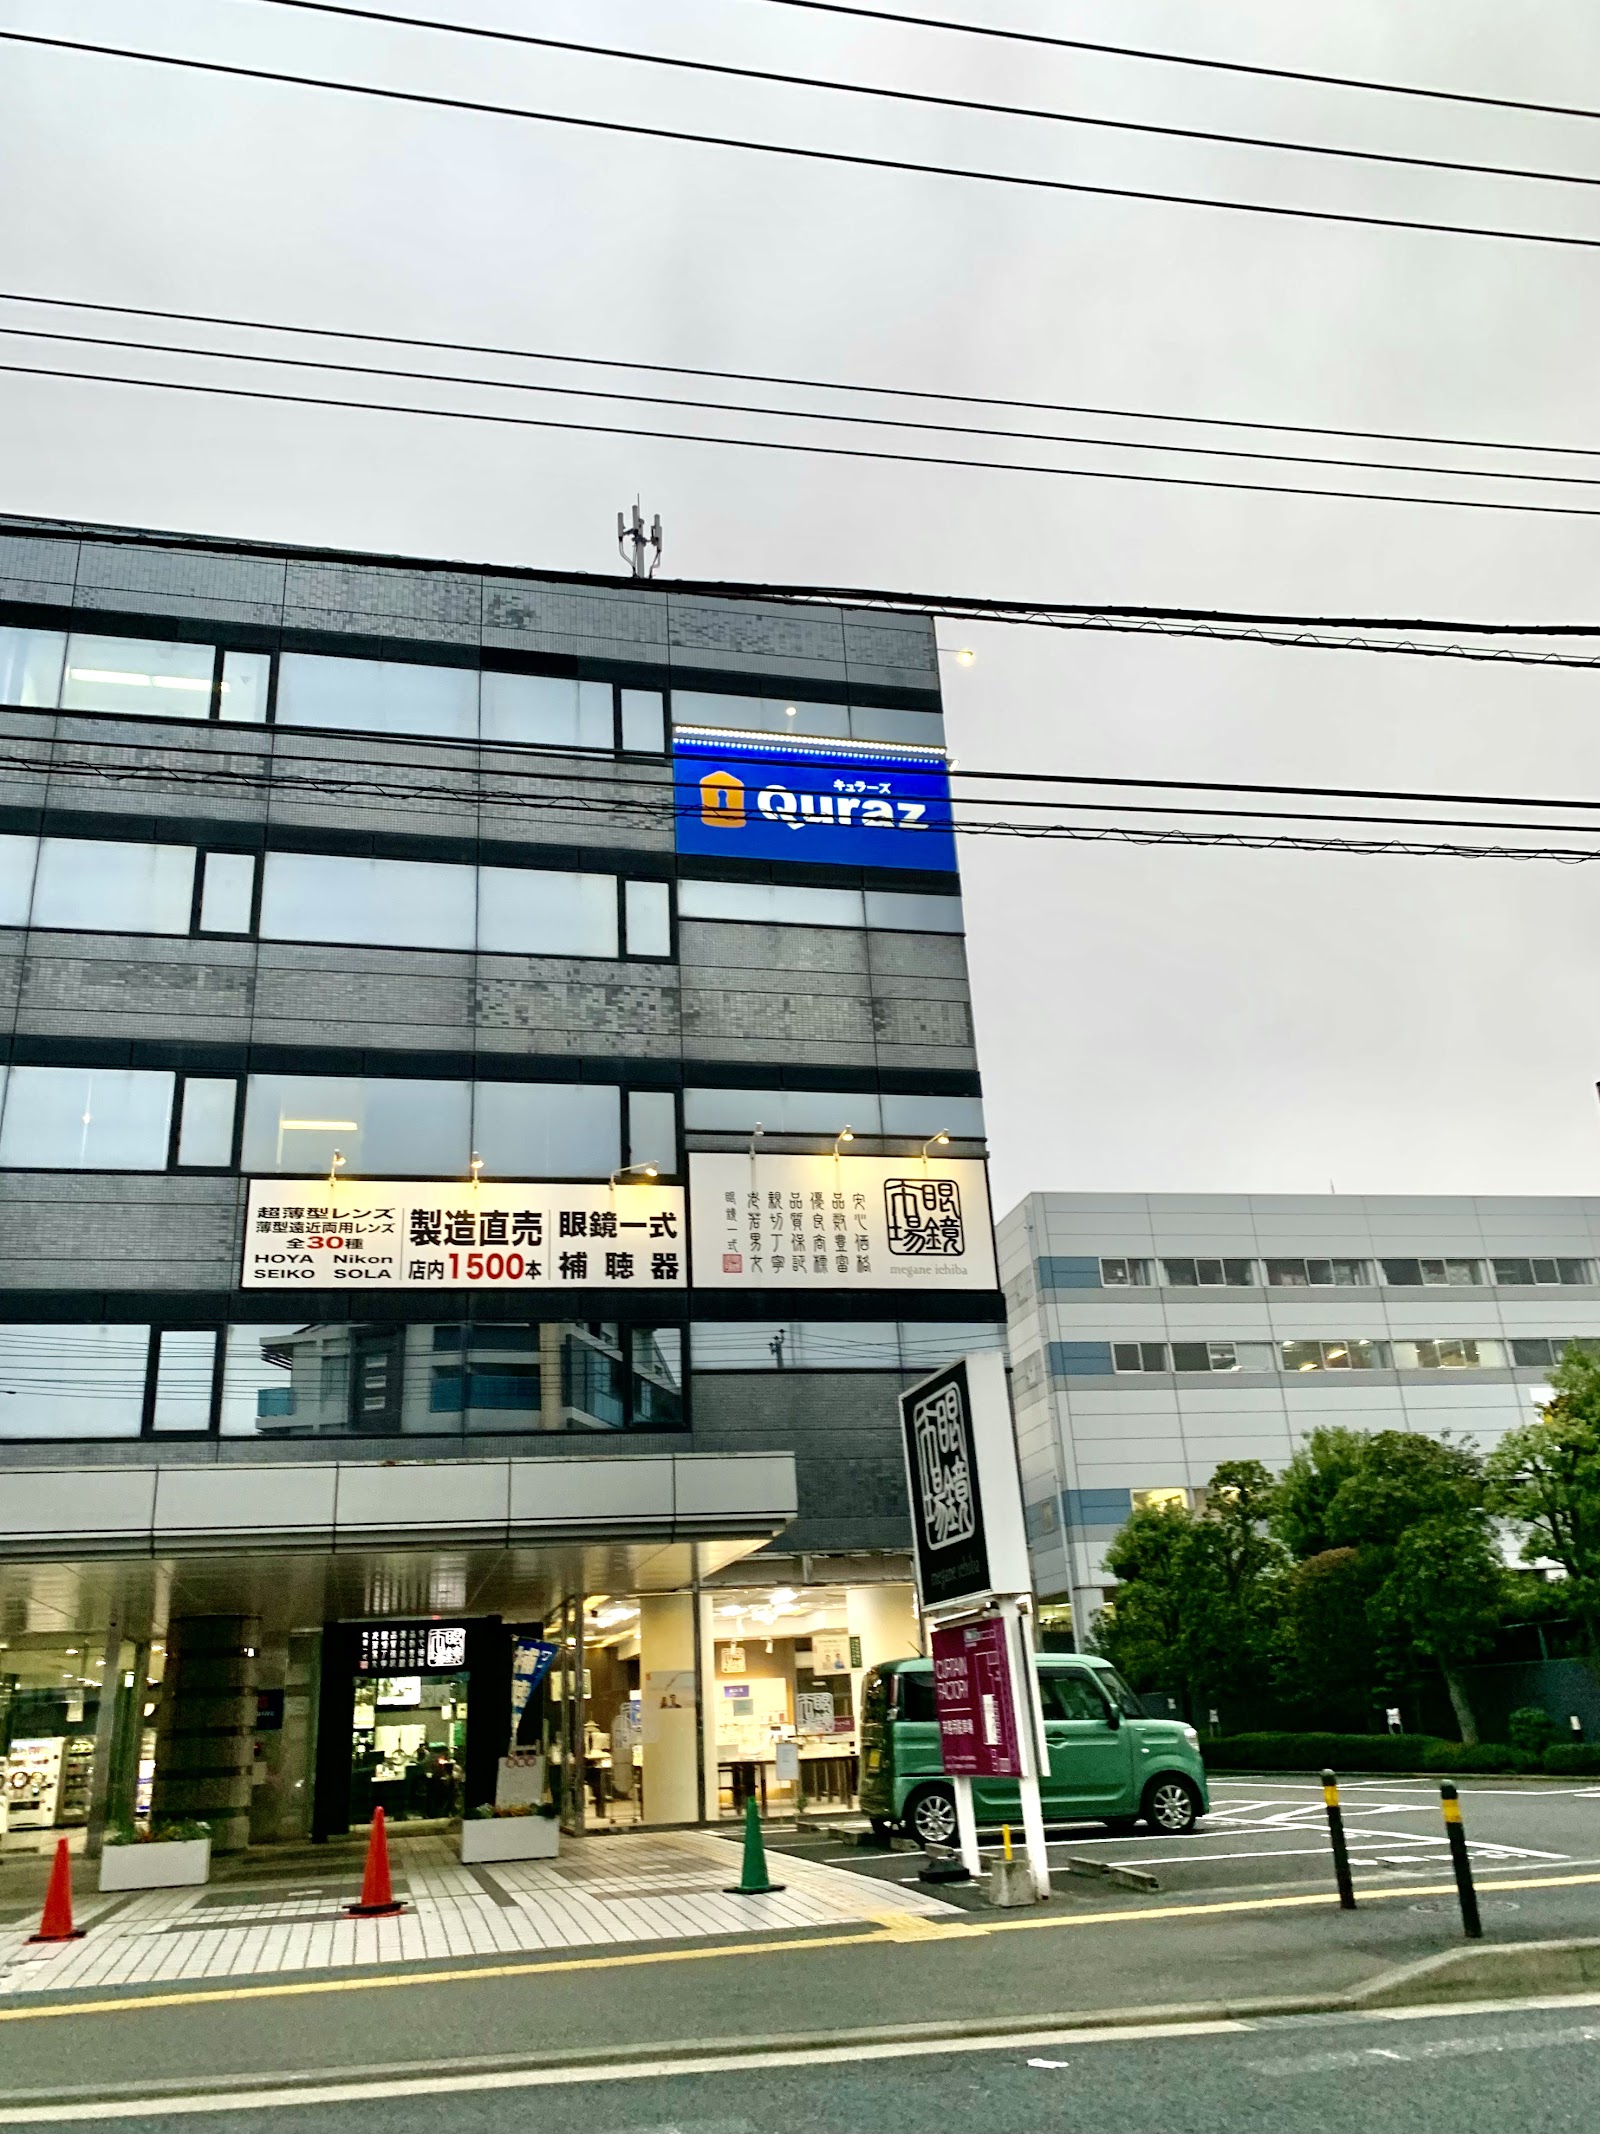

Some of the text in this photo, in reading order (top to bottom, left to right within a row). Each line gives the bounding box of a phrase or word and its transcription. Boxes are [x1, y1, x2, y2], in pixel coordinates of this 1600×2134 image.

[832, 778, 891, 795] キュラーズ
[757, 785, 930, 830] Quraz
[257, 1207, 396, 1219] 超薄型レンズ
[255, 1221, 396, 1234] 薄型遠近両用レンズ
[409, 1209, 543, 1247] 製造直売
[558, 1211, 678, 1239] 眼鏡一式
[286, 1236, 364, 1250] 全30種
[254, 1254, 393, 1264] HOYA Nikon
[408, 1253, 542, 1280] 店内1500本
[558, 1251, 679, 1280] 補聴器
[253, 1269, 392, 1279] SEIKO SOLA
[890, 1263, 968, 1278] megane ichiba
